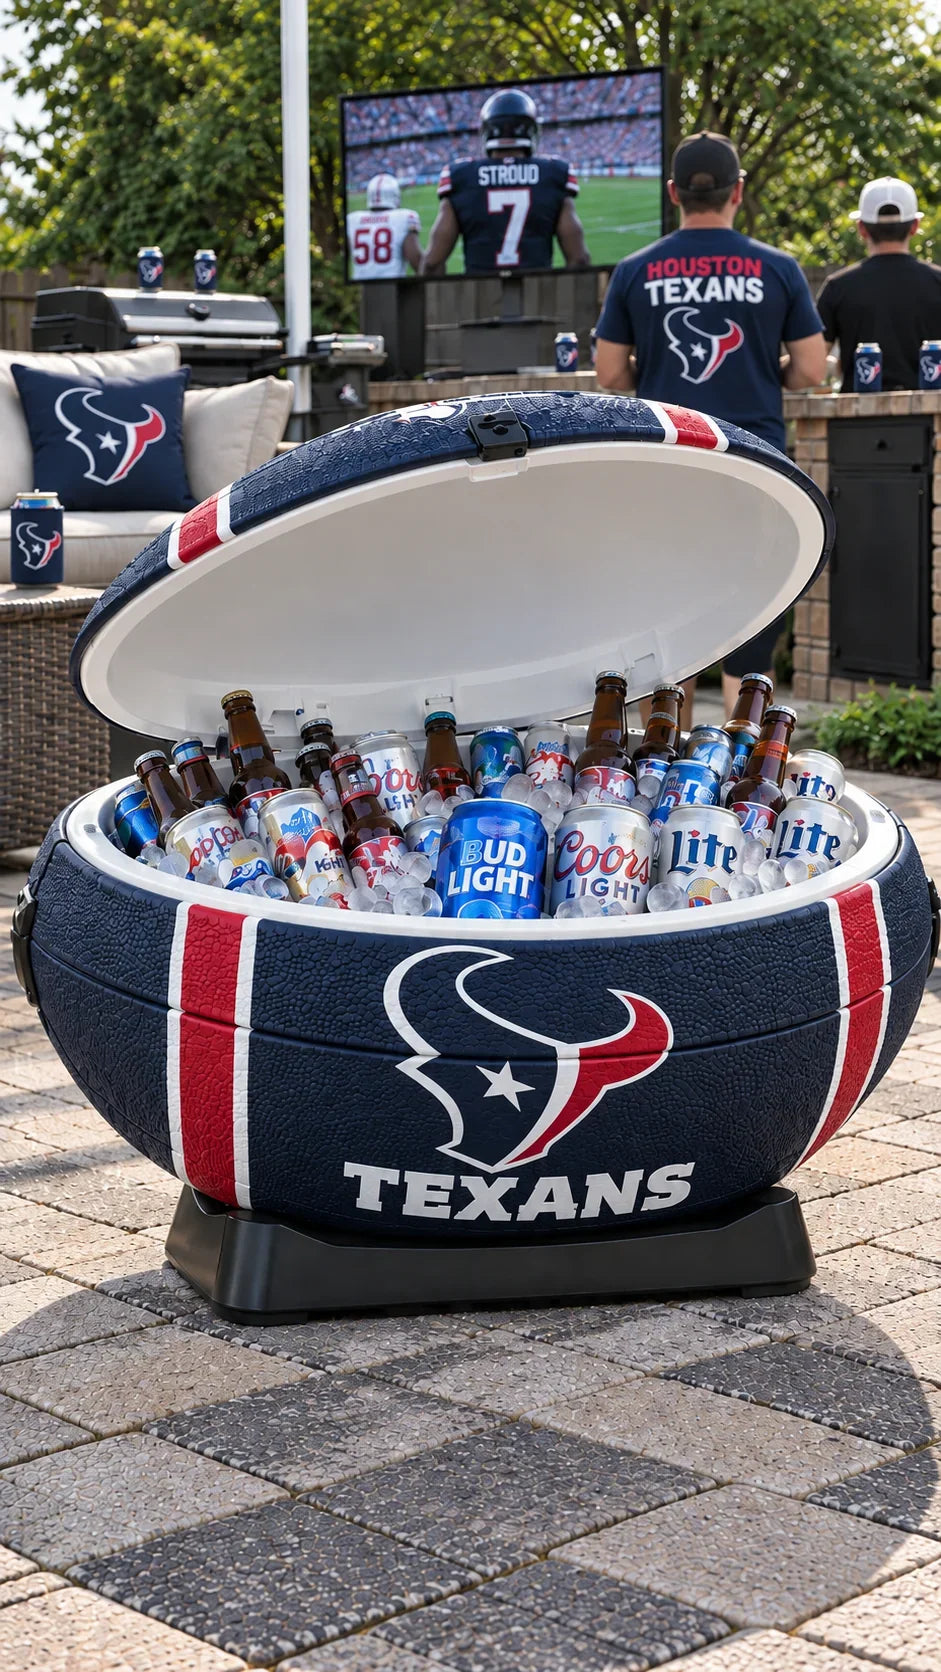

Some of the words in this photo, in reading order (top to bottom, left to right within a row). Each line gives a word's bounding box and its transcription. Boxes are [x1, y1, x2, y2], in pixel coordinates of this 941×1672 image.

[478, 164, 540, 187] STROUD
[487, 187, 531, 267] 7
[354, 227, 393, 265] 58
[646, 256, 763, 280] HOUSTON
[644, 276, 764, 307] TEXANS
[460, 839, 528, 868] BUD
[554, 829, 651, 884] Coors
[667, 829, 739, 875] Lite
[775, 819, 841, 865] Lite
[447, 867, 535, 899] LIGHT
[565, 877, 641, 904] LIGHT
[343, 1161, 696, 1222] TEXANS
